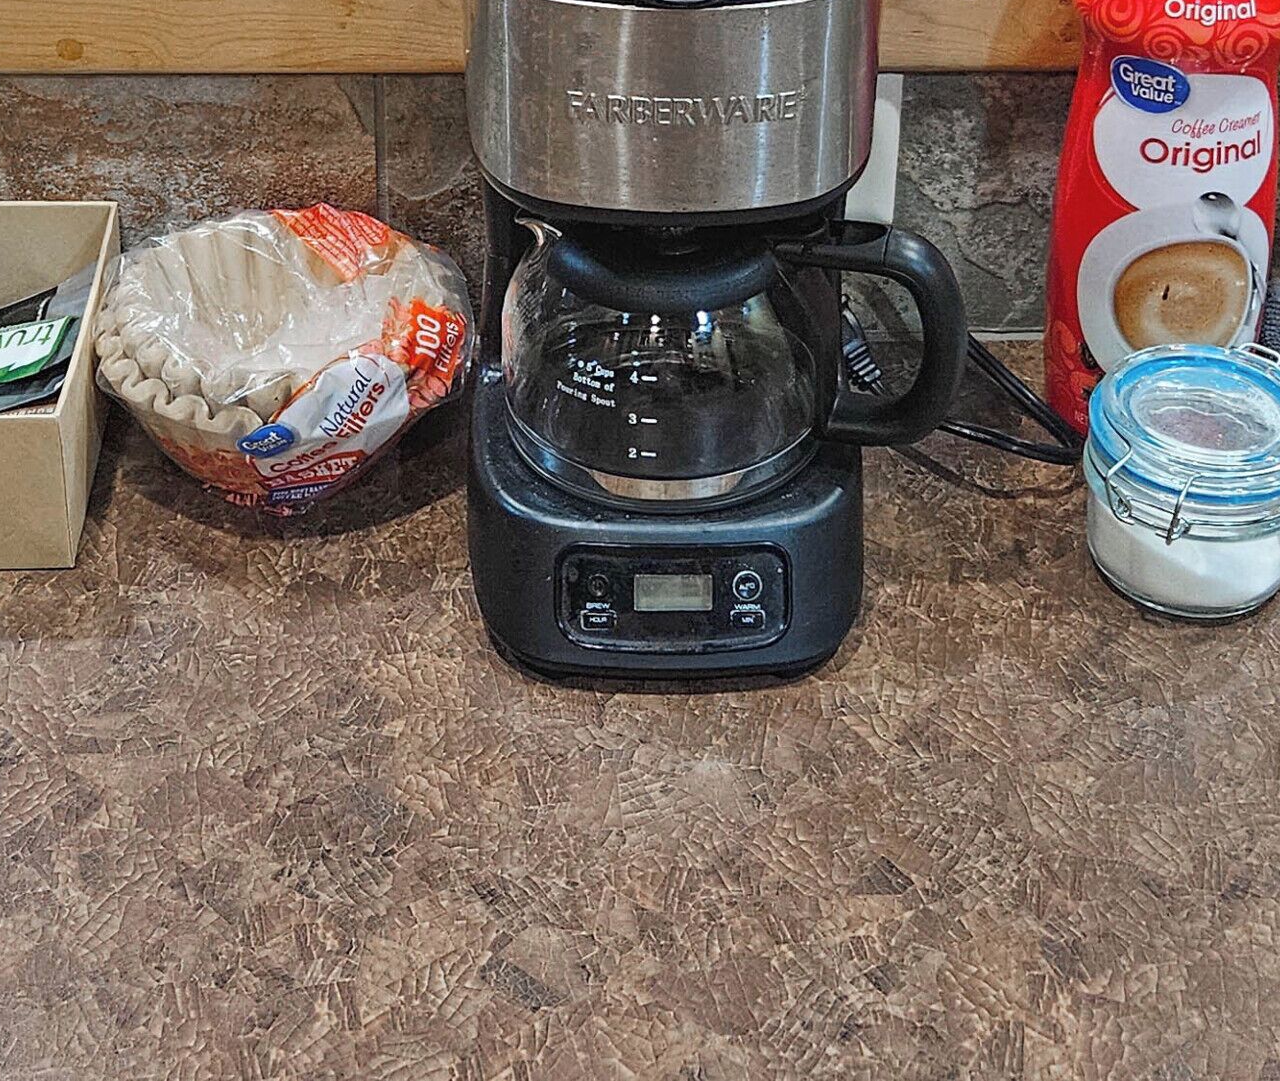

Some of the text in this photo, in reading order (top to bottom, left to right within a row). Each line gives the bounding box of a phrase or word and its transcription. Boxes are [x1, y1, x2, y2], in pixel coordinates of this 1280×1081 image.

[1120, 63, 1176, 92] Great
[1131, 83, 1175, 104] Value
[567, 90, 797, 126] FARBERWARE
[1171, 111, 1262, 139] Coffee Creamer
[1139, 130, 1261, 173] Original
[415, 313, 441, 358] 100
[435, 321, 460, 373] Filters
[572, 372, 616, 392] Bottom of
[629, 370, 639, 384] 4
[319, 367, 372, 438] Natural
[556, 380, 616, 407] Pouring Spout
[336, 381, 386, 439] Filters
[628, 413, 637, 424] 3
[628, 447, 637, 458] 2
